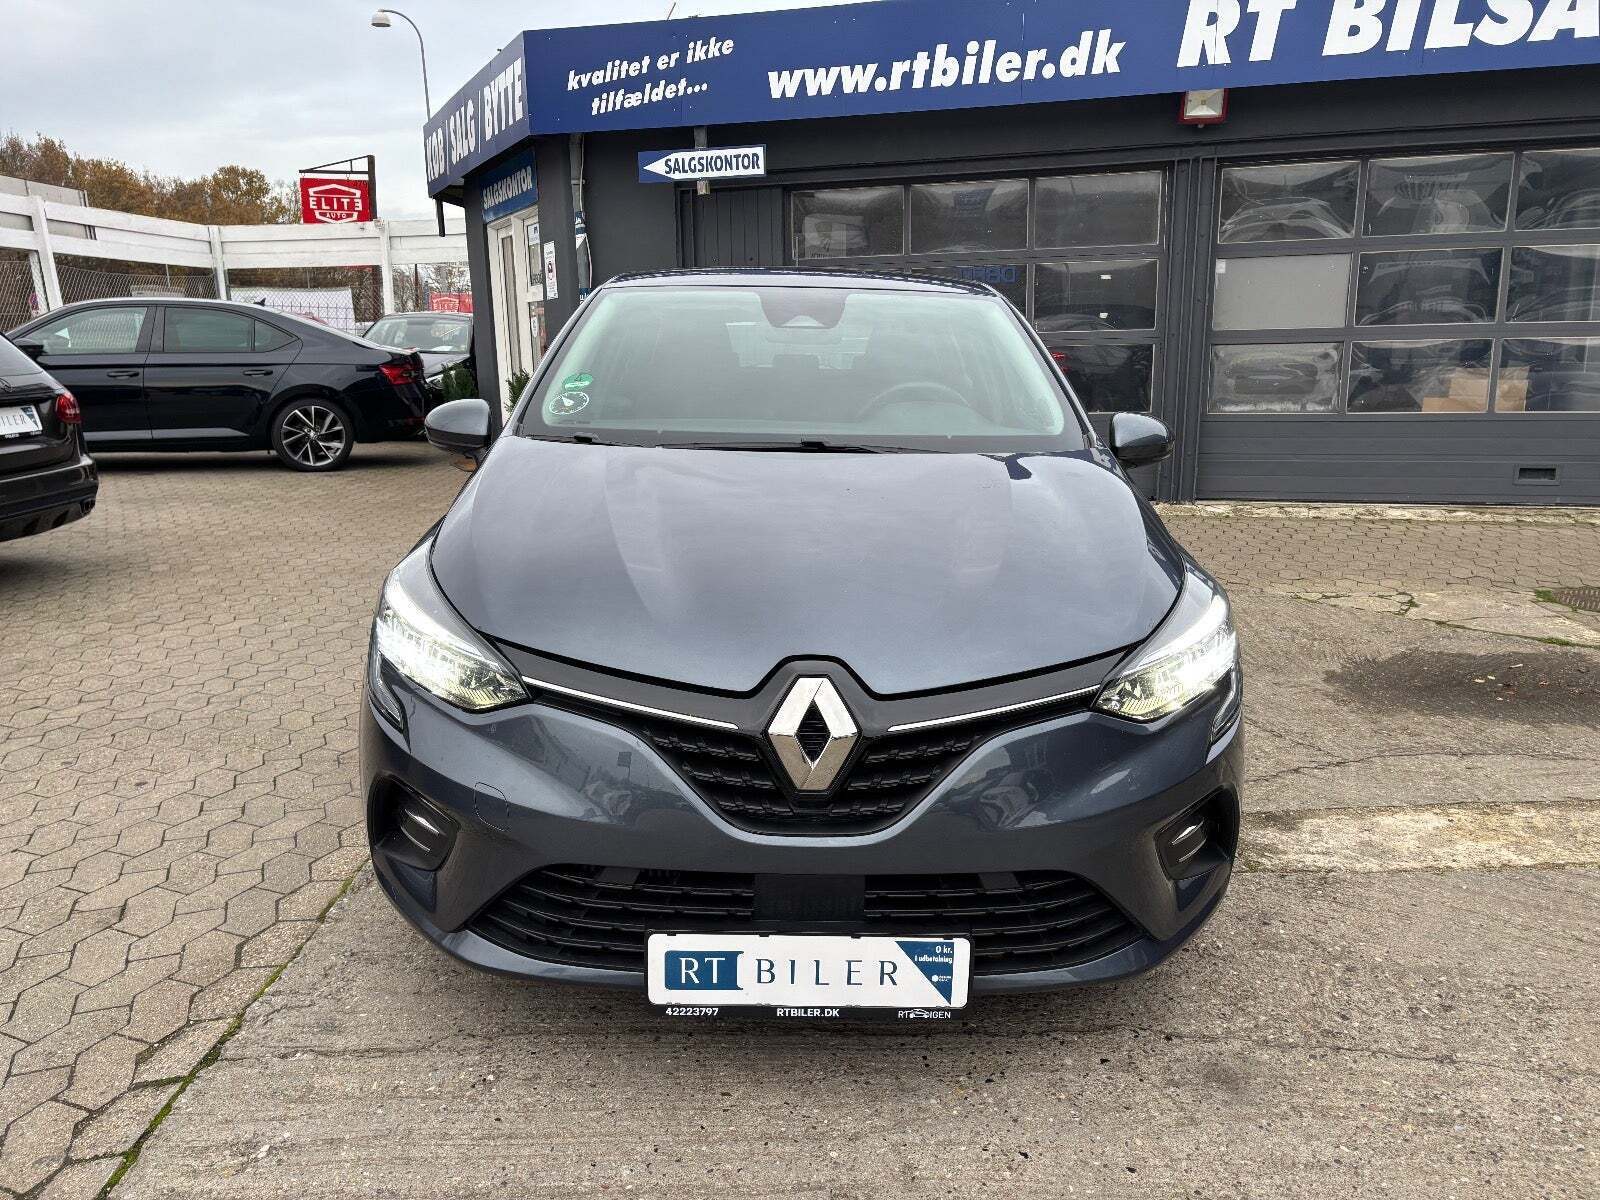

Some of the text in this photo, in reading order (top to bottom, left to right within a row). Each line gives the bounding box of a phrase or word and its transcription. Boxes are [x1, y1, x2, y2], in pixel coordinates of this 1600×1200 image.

[1177, 0, 1296, 68] RT
[567, 36, 734, 91] kvalitet er ikke
[767, 29, 1126, 99] www.rtbiler.dk
[450, 99, 476, 166] SALG
[483, 57, 524, 142] BYTTE
[591, 78, 708, 116] tilfældet...
[664, 152, 761, 175] SALGSKONTOR
[483, 166, 533, 210] SALGSKONTOR
[309, 197, 362, 211] ELITE
[918, 955, 953, 964] udbetaling
[935, 945, 953, 954] 0 kr.
[680, 957, 898, 986] RT BILER
[665, 1007, 719, 1016] 42223797
[776, 1008, 840, 1017] RTBILER.DK
